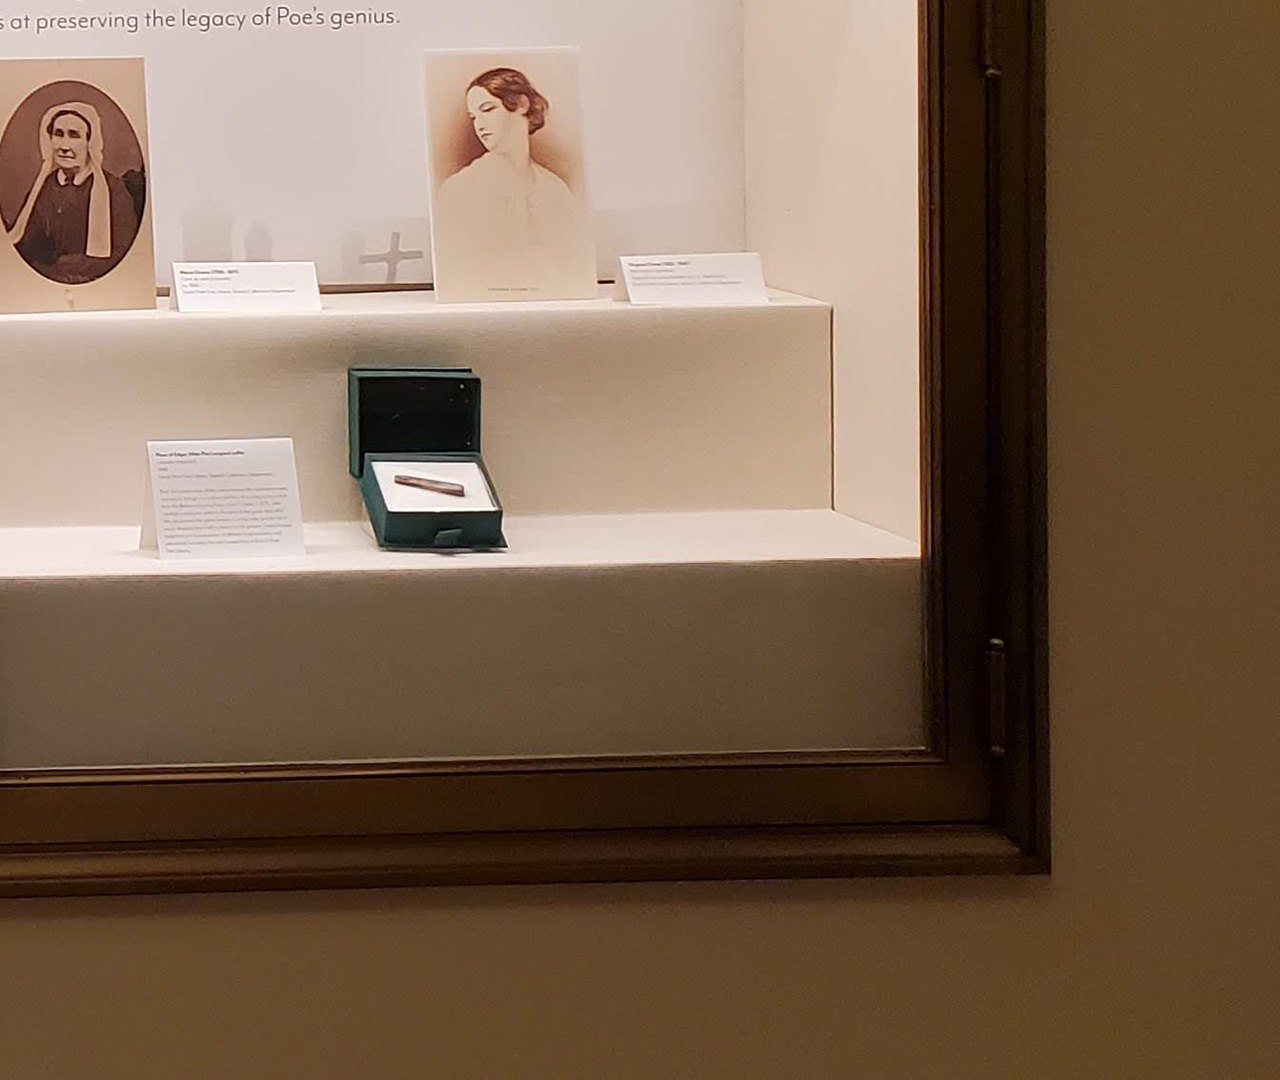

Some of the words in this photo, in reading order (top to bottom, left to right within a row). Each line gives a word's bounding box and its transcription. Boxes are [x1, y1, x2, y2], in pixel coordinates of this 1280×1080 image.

[9, 14, 31, 30] at
[36, 11, 139, 35] preserving
[143, 7, 177, 28] the
[181, 7, 247, 33] legacy
[251, 5, 276, 26] of
[330, 7, 401, 31] genius.
